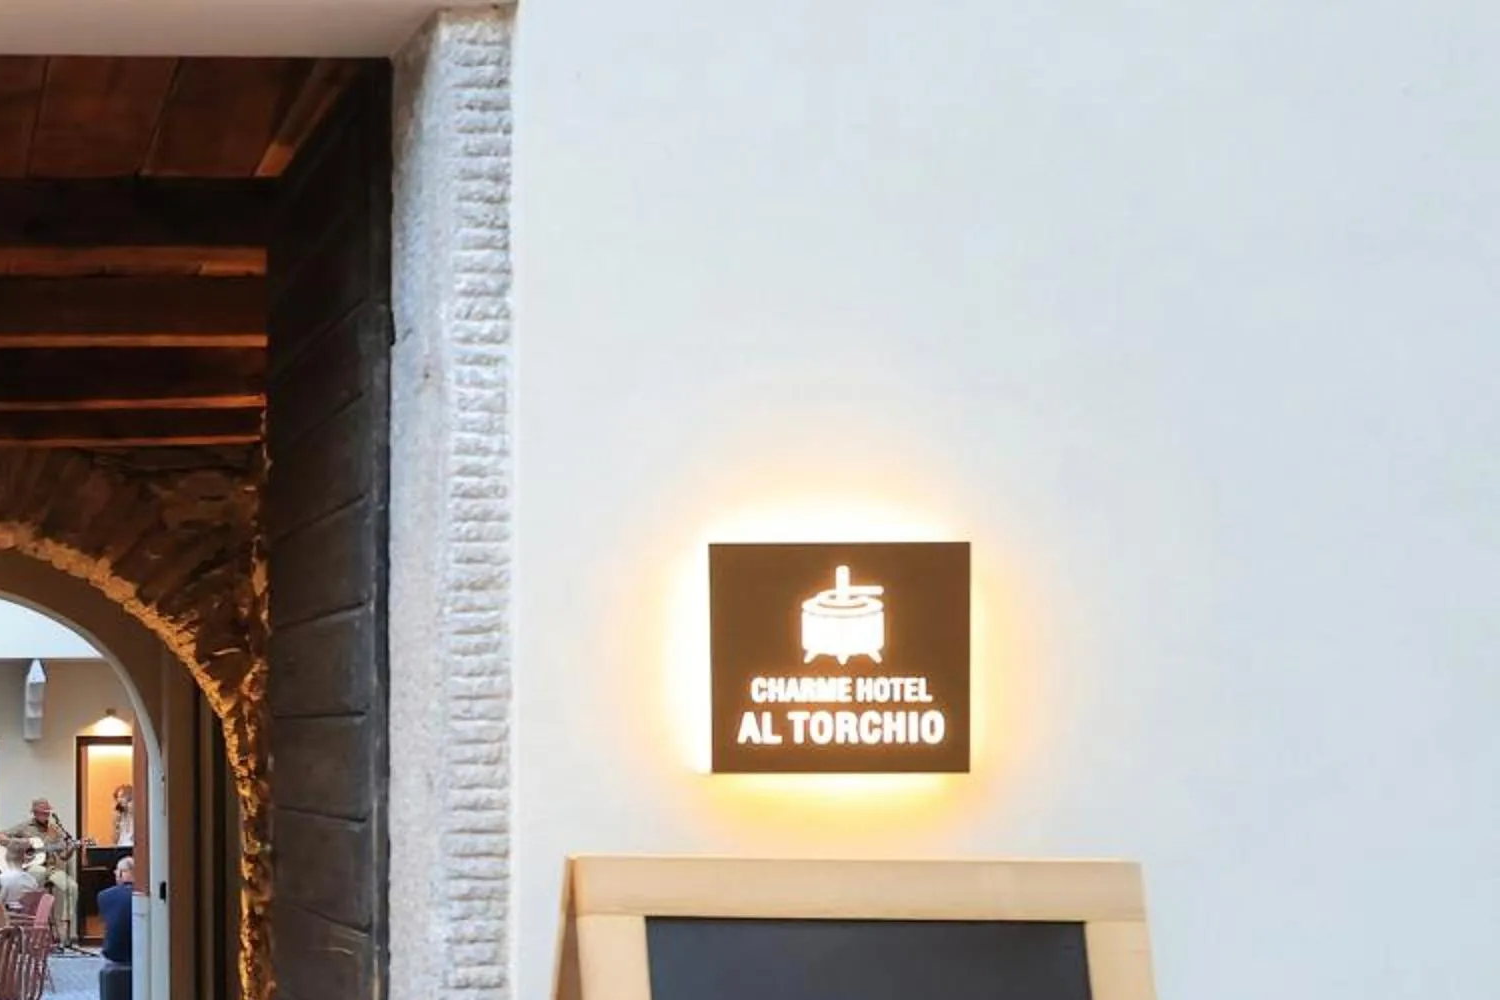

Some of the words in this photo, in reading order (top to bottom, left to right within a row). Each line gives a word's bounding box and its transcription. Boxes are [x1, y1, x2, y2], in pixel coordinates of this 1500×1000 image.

[750, 677, 852, 703] CHARME
[856, 677, 933, 703] HOTEL
[737, 711, 783, 745] AL
[786, 710, 945, 745] TORCHIO
